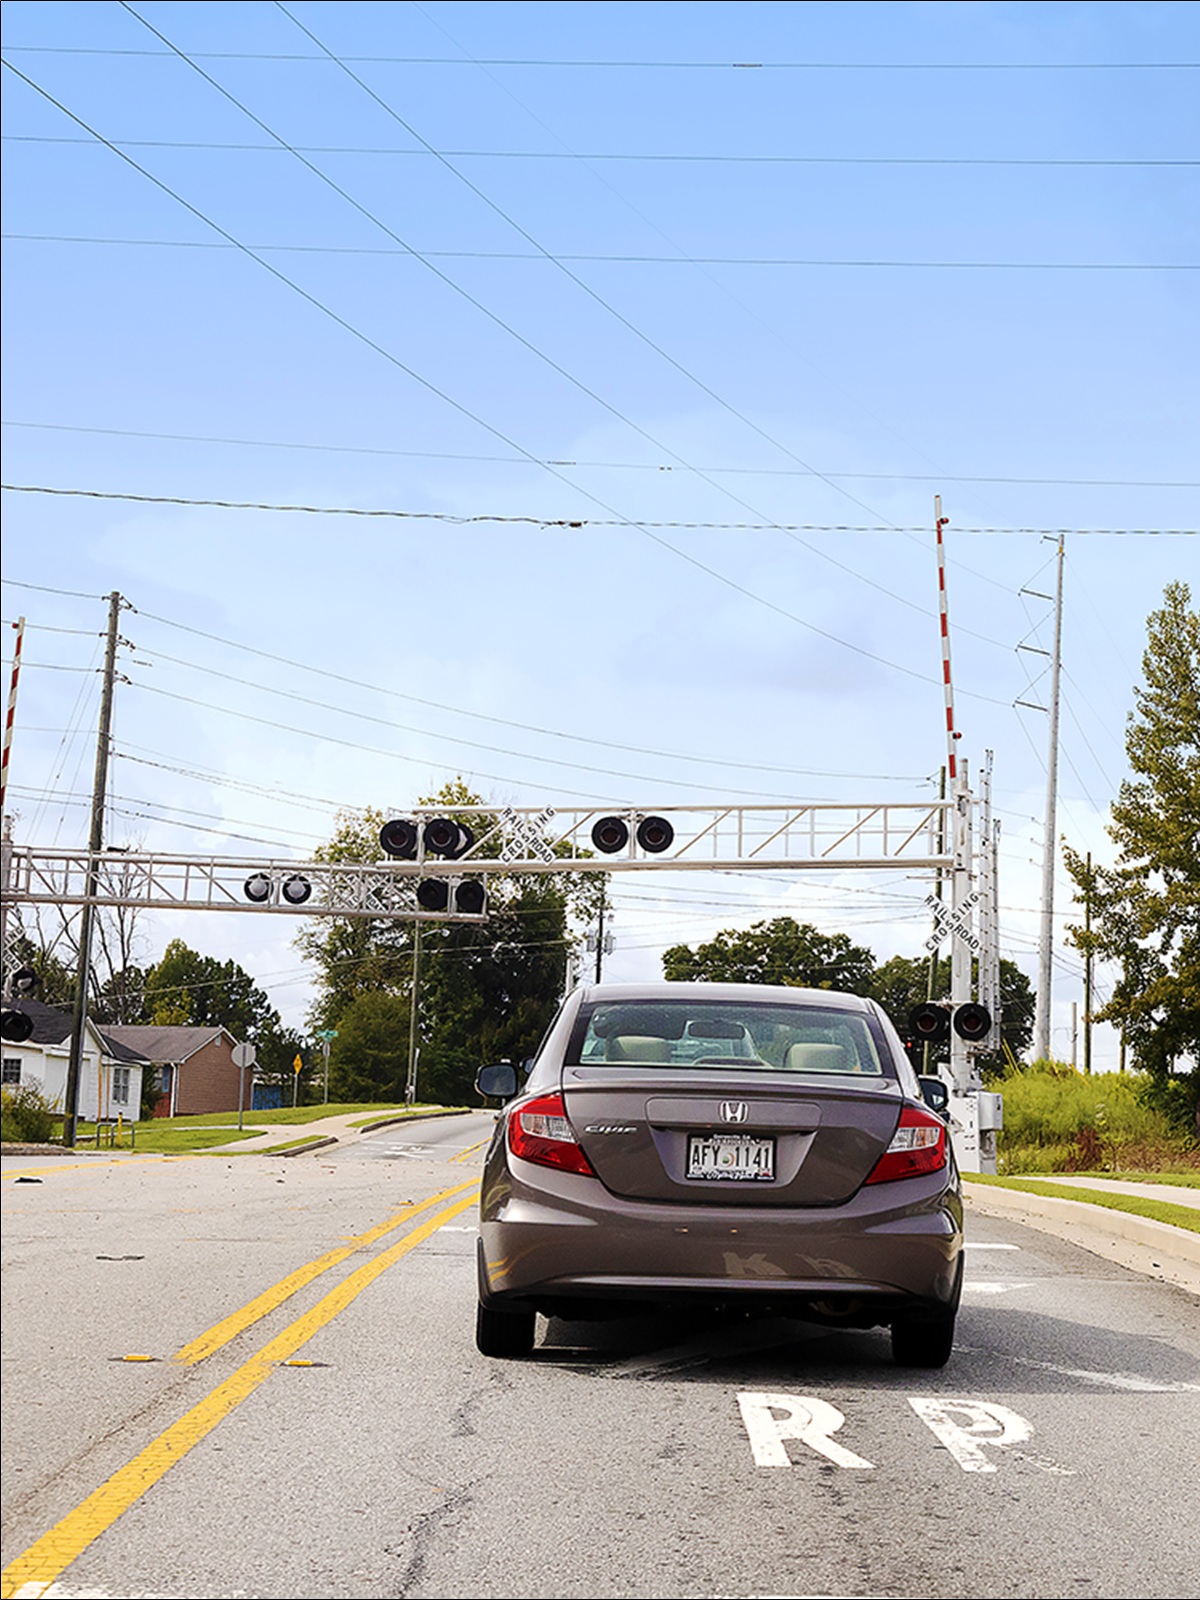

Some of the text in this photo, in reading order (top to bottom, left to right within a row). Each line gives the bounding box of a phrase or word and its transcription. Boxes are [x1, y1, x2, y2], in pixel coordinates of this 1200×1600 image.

[501, 807, 555, 863] CROSSING
[503, 807, 553, 863] RAIL ROAD
[924, 894, 980, 950] RAIL ROAD
[925, 893, 980, 951] CROSSING
[691, 1145, 770, 1169] AFY 1141
[736, 1391, 878, 1469] R
